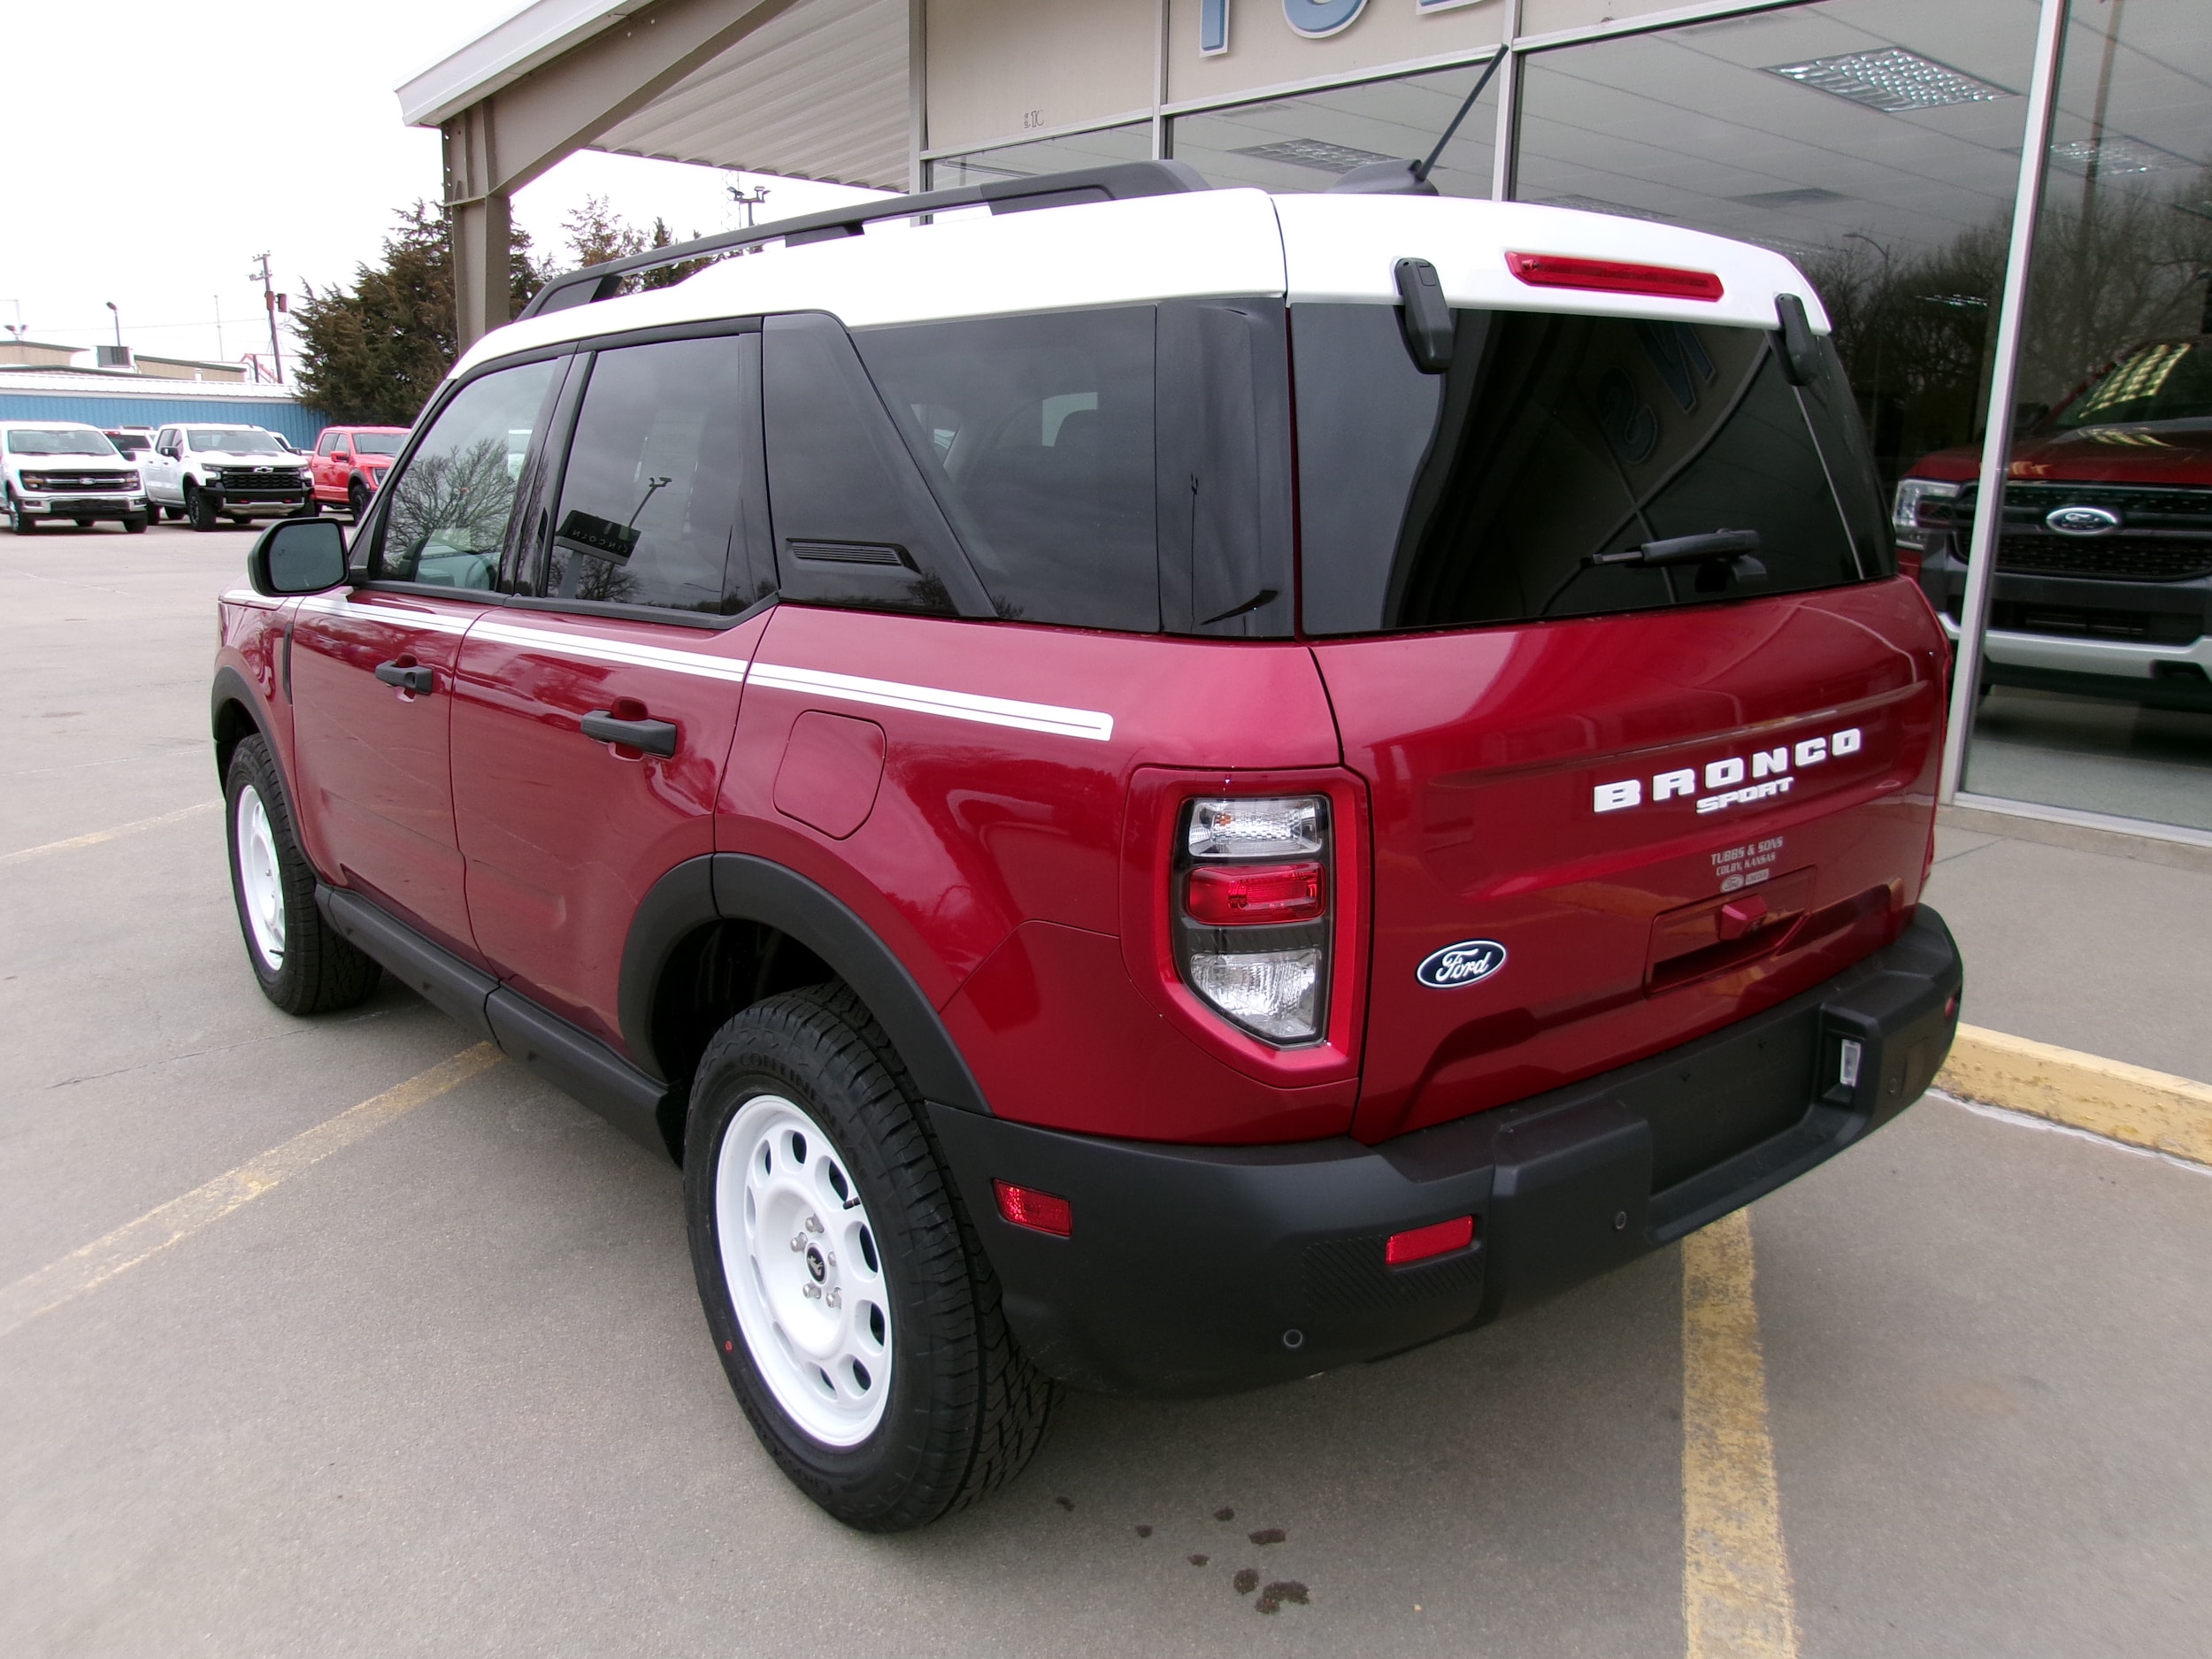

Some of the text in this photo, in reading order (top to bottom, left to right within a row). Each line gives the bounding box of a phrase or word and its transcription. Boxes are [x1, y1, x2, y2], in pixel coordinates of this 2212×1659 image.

[1593, 727, 1862, 814] BRONCO
[1695, 776, 1795, 814] SPORT
[1710, 836, 1783, 865] TUBBS & SONS
[1744, 851, 1776, 868] KANSAS
